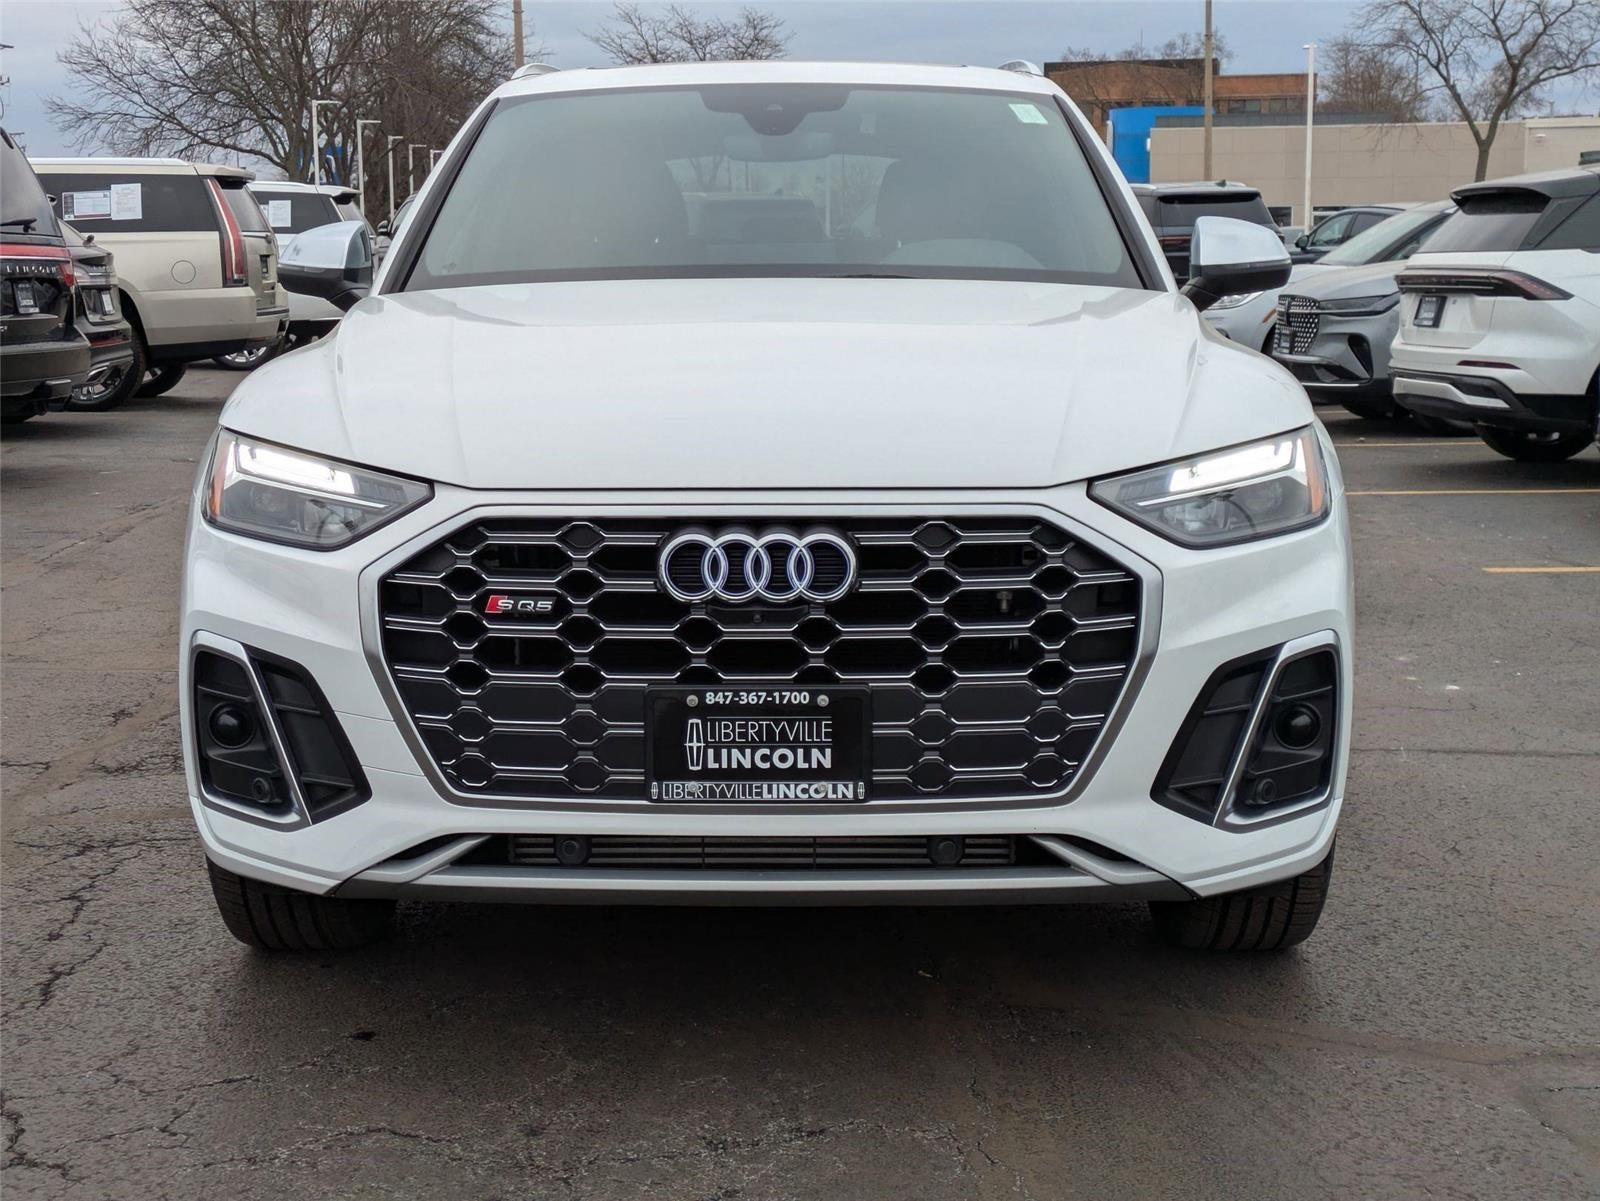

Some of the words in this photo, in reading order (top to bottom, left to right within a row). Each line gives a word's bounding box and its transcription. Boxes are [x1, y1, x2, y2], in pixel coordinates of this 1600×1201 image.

[705, 691, 810, 705] 847-367-1700
[707, 720, 833, 742] LIBERTYVILLE
[707, 748, 832, 769] LINCOLN
